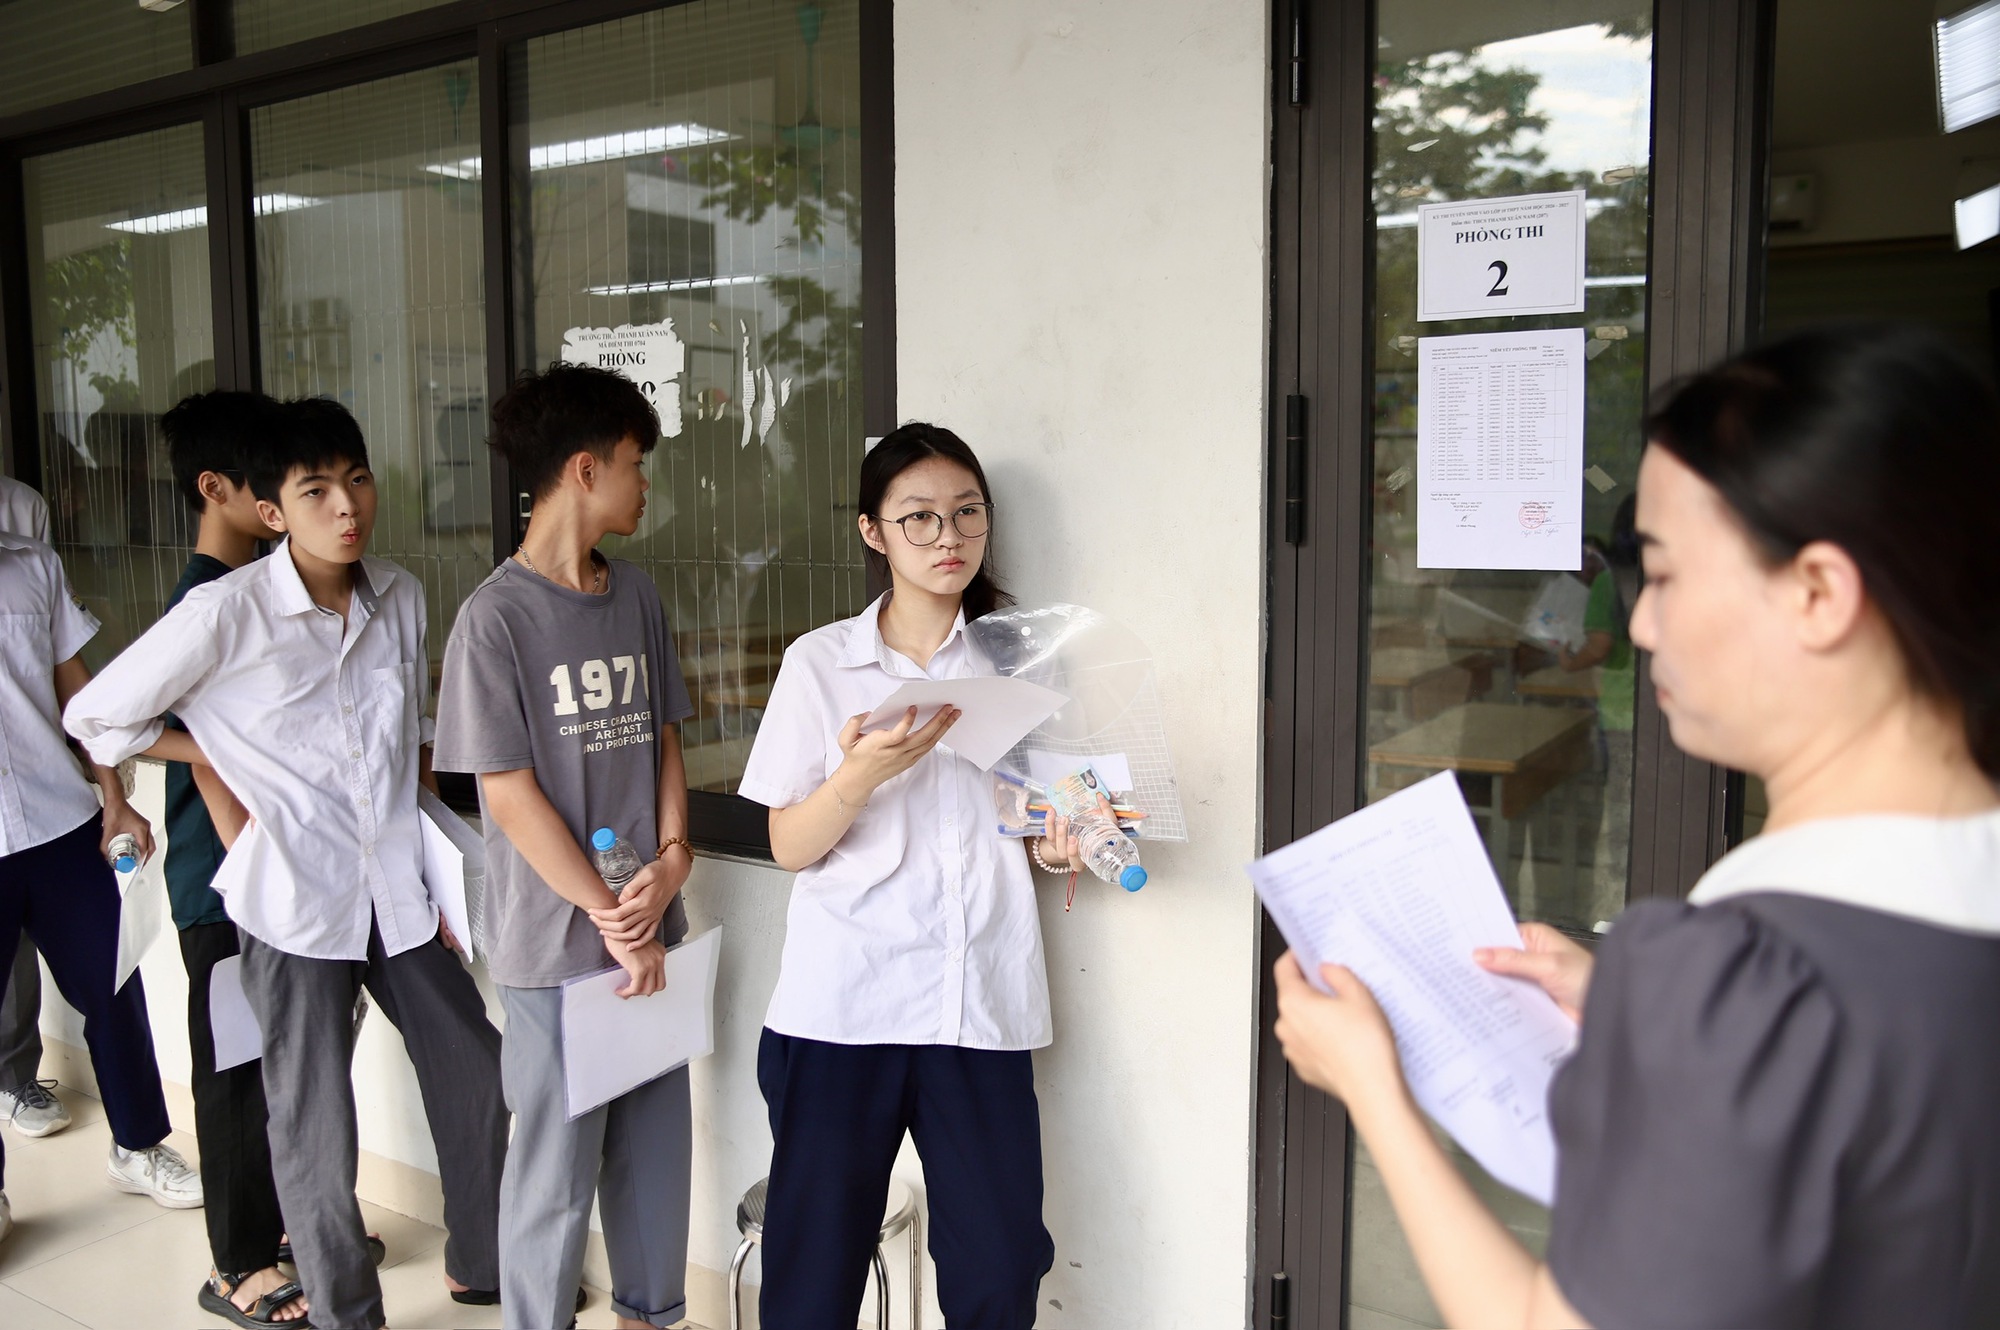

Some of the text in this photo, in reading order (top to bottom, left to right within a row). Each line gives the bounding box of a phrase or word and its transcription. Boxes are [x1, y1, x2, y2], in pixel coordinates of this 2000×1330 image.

[1456, 225, 1544, 244] PHÒNG THI
[1486, 260, 1509, 297] 2
[598, 349, 646, 366] PHÒNG
[560, 719, 608, 736] CHINESE
